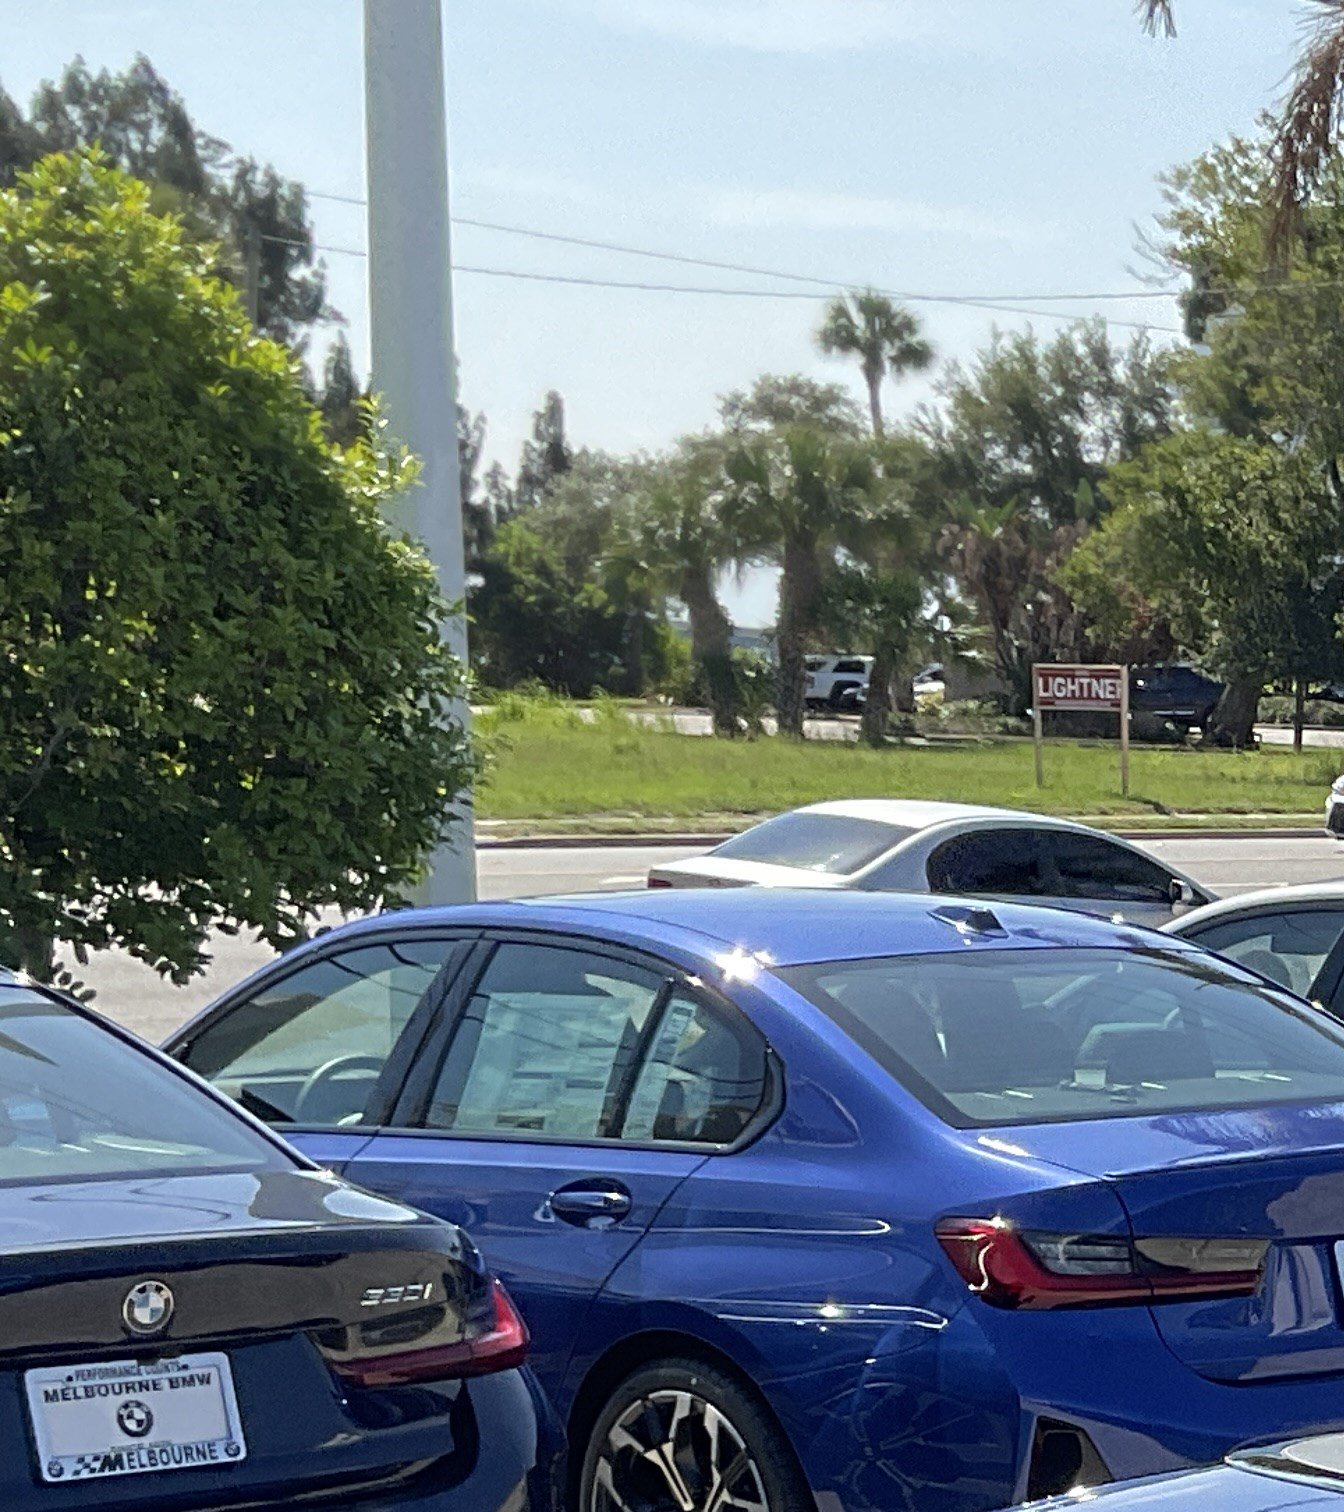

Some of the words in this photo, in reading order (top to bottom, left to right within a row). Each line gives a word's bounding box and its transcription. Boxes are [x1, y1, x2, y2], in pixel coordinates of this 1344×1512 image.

[43, 1378, 164, 1404] MELBOURNE
[169, 1372, 212, 1389] BMW
[99, 1443, 219, 1473] MELBOURNE
